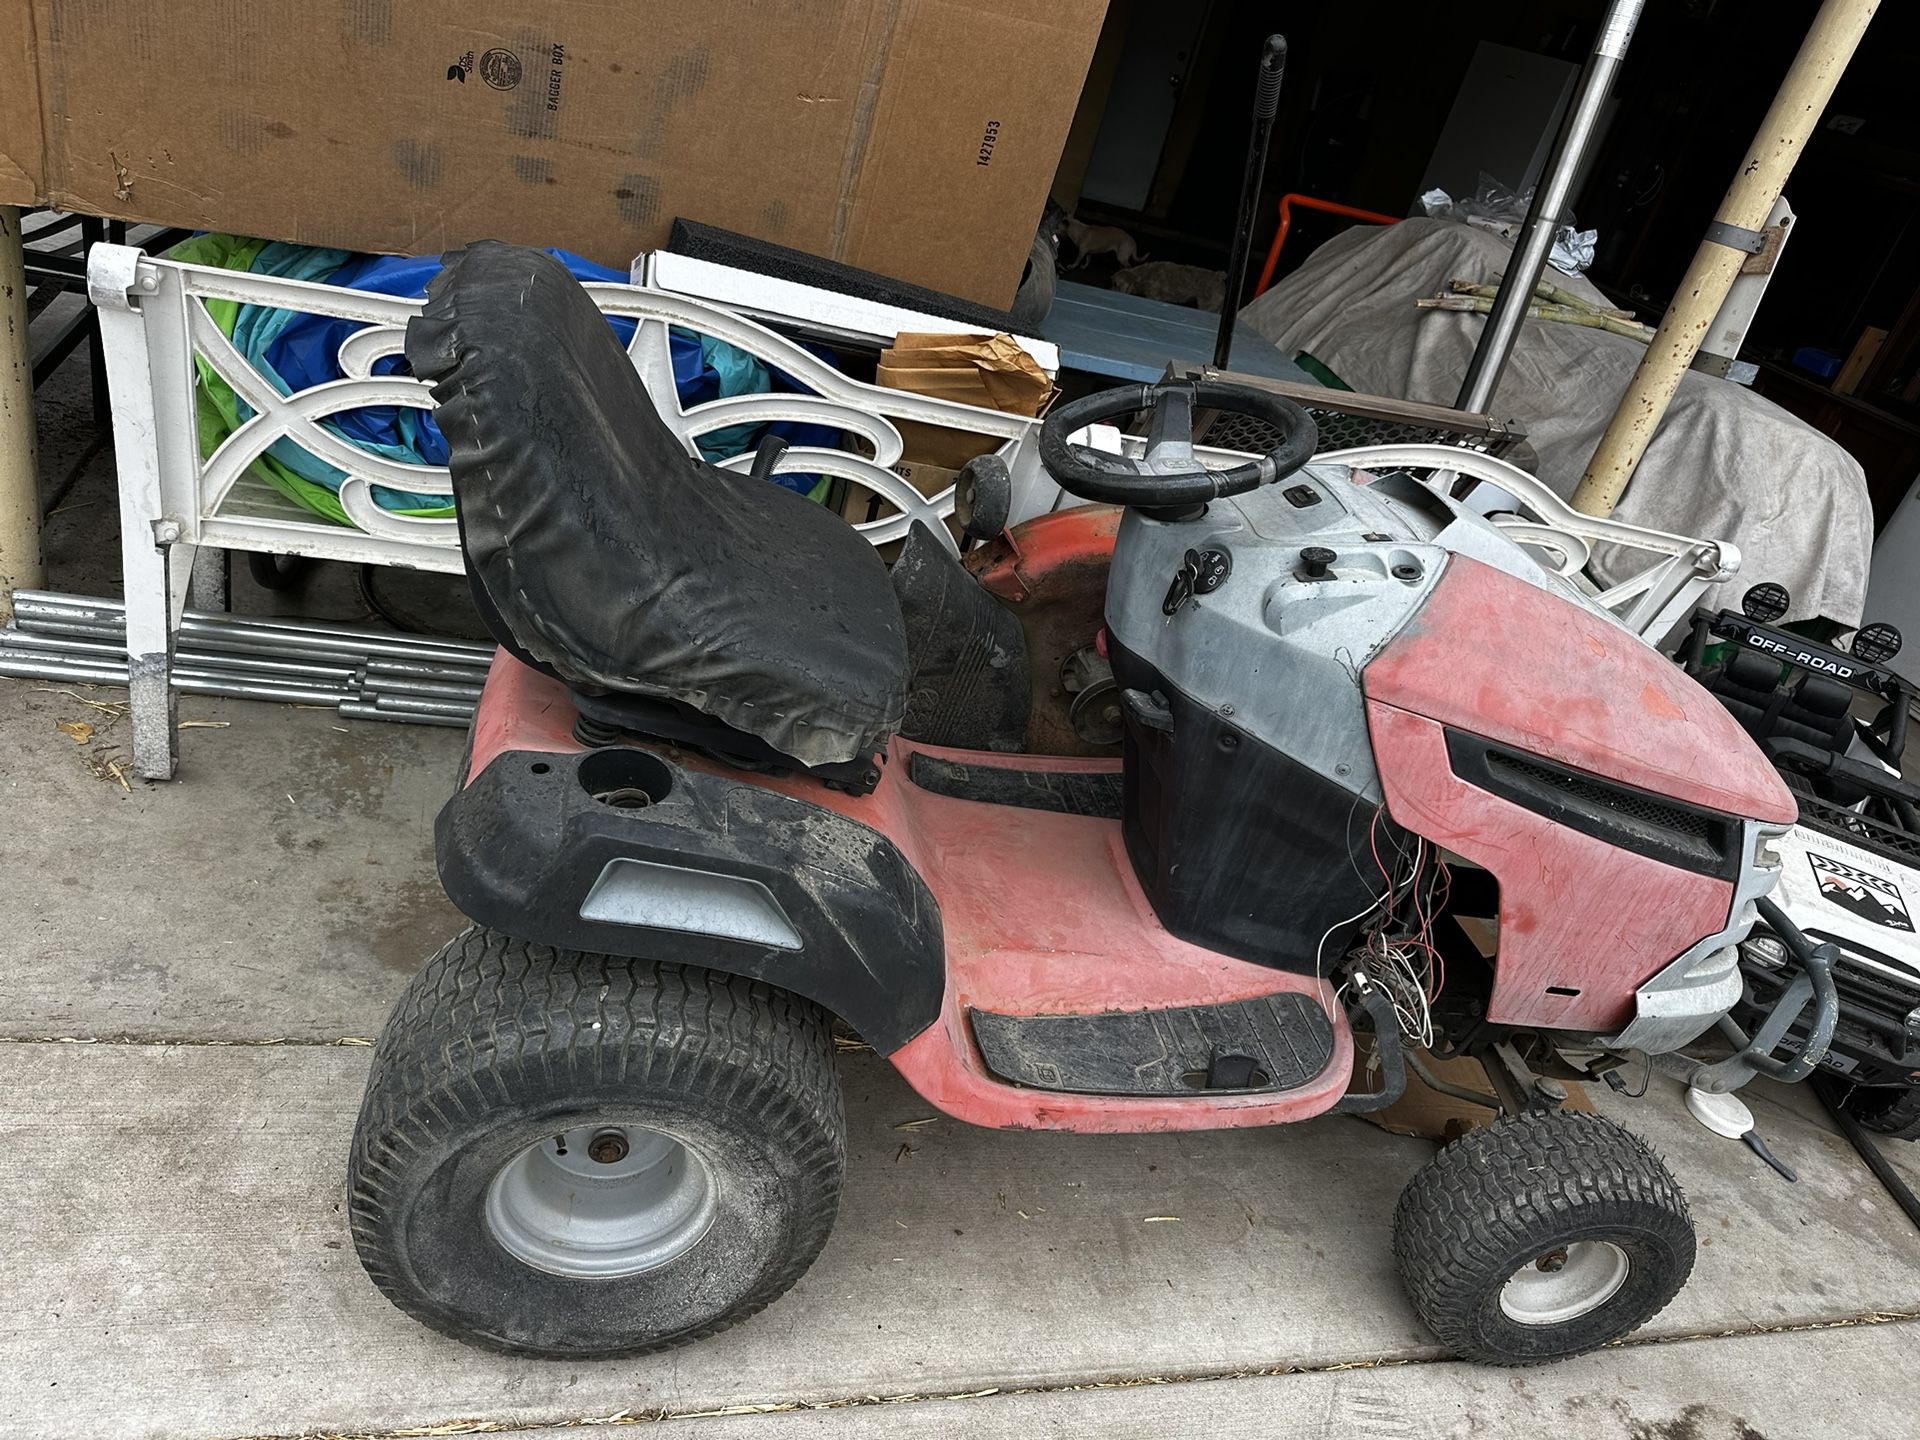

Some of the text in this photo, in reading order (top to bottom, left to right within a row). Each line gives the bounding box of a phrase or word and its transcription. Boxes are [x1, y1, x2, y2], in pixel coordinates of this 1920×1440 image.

[459, 56, 467, 68] DS
[465, 50, 475, 73] Smith
[547, 43, 565, 111] BAGGER BOX
[976, 121, 1001, 167] 1427953
[1749, 634, 1853, 678] OFF-ROAD
